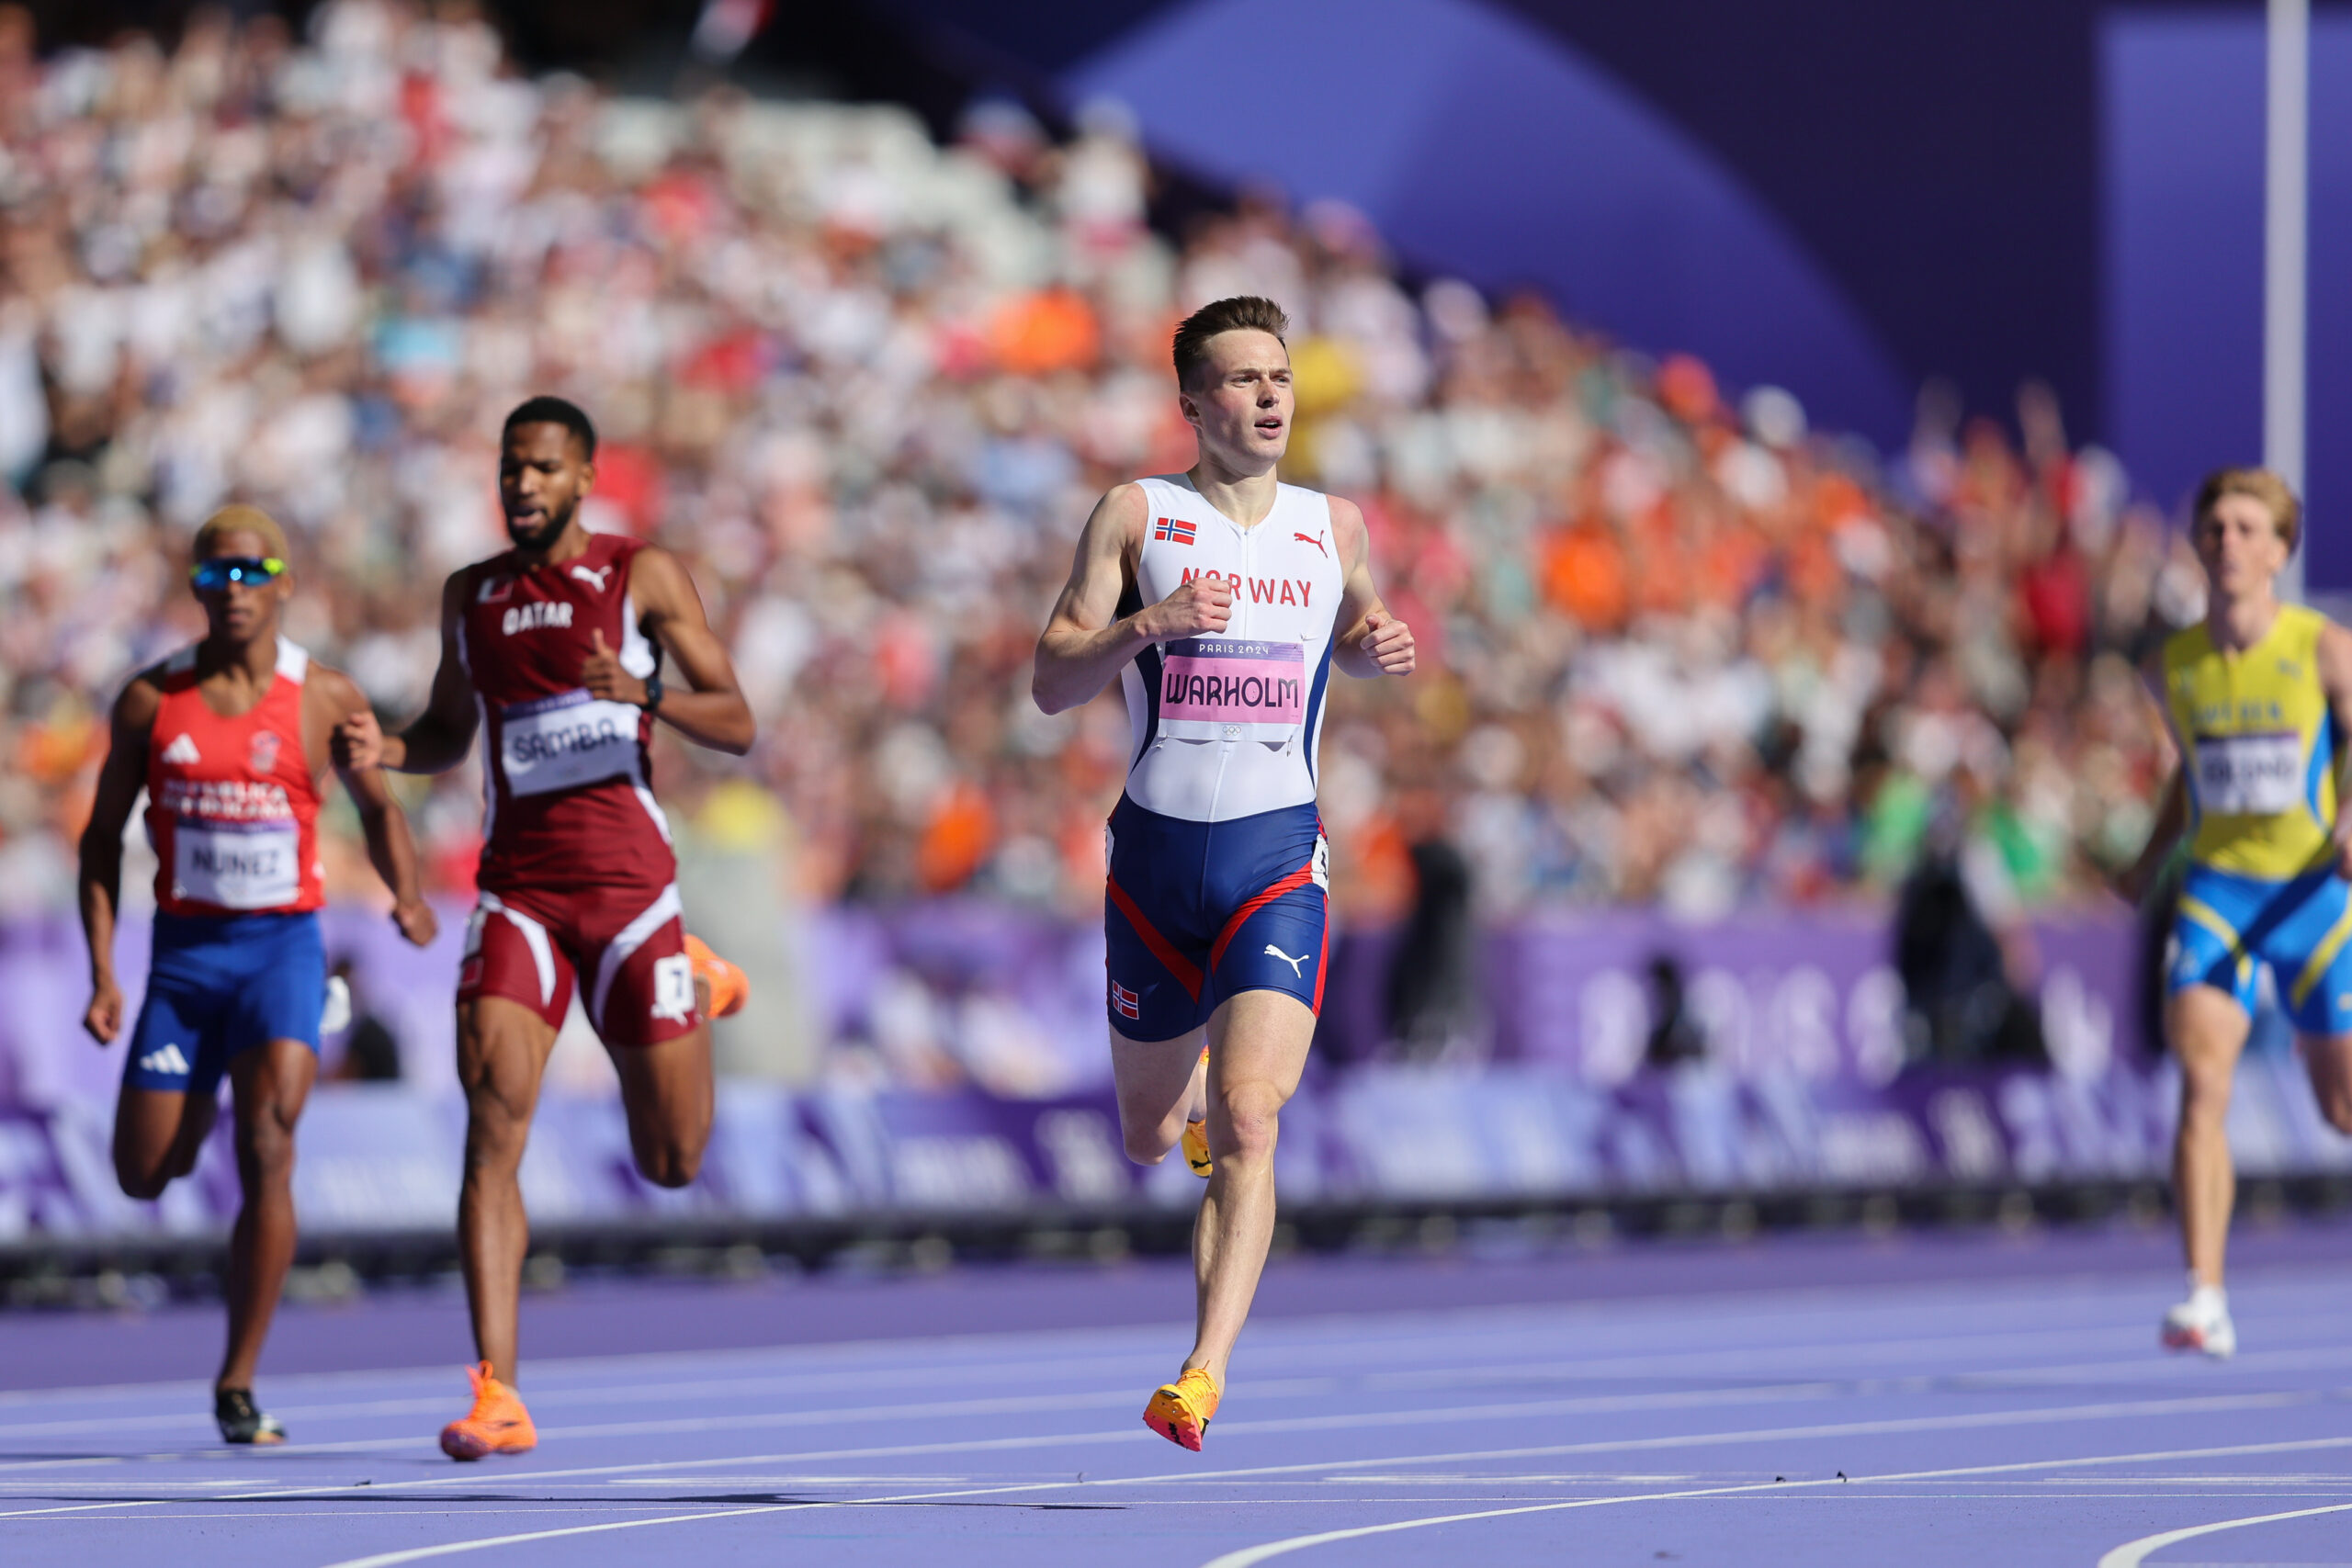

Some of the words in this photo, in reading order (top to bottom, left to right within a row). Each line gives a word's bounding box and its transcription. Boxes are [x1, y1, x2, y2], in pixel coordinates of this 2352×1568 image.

[502, 601, 573, 636] QATAR
[1199, 644, 1234, 653] PARIS
[1238, 645, 1270, 654] 2024
[1165, 673, 1298, 708] WARHOLM
[514, 717, 619, 763] SAMBA
[671, 967, 684, 999] 7
